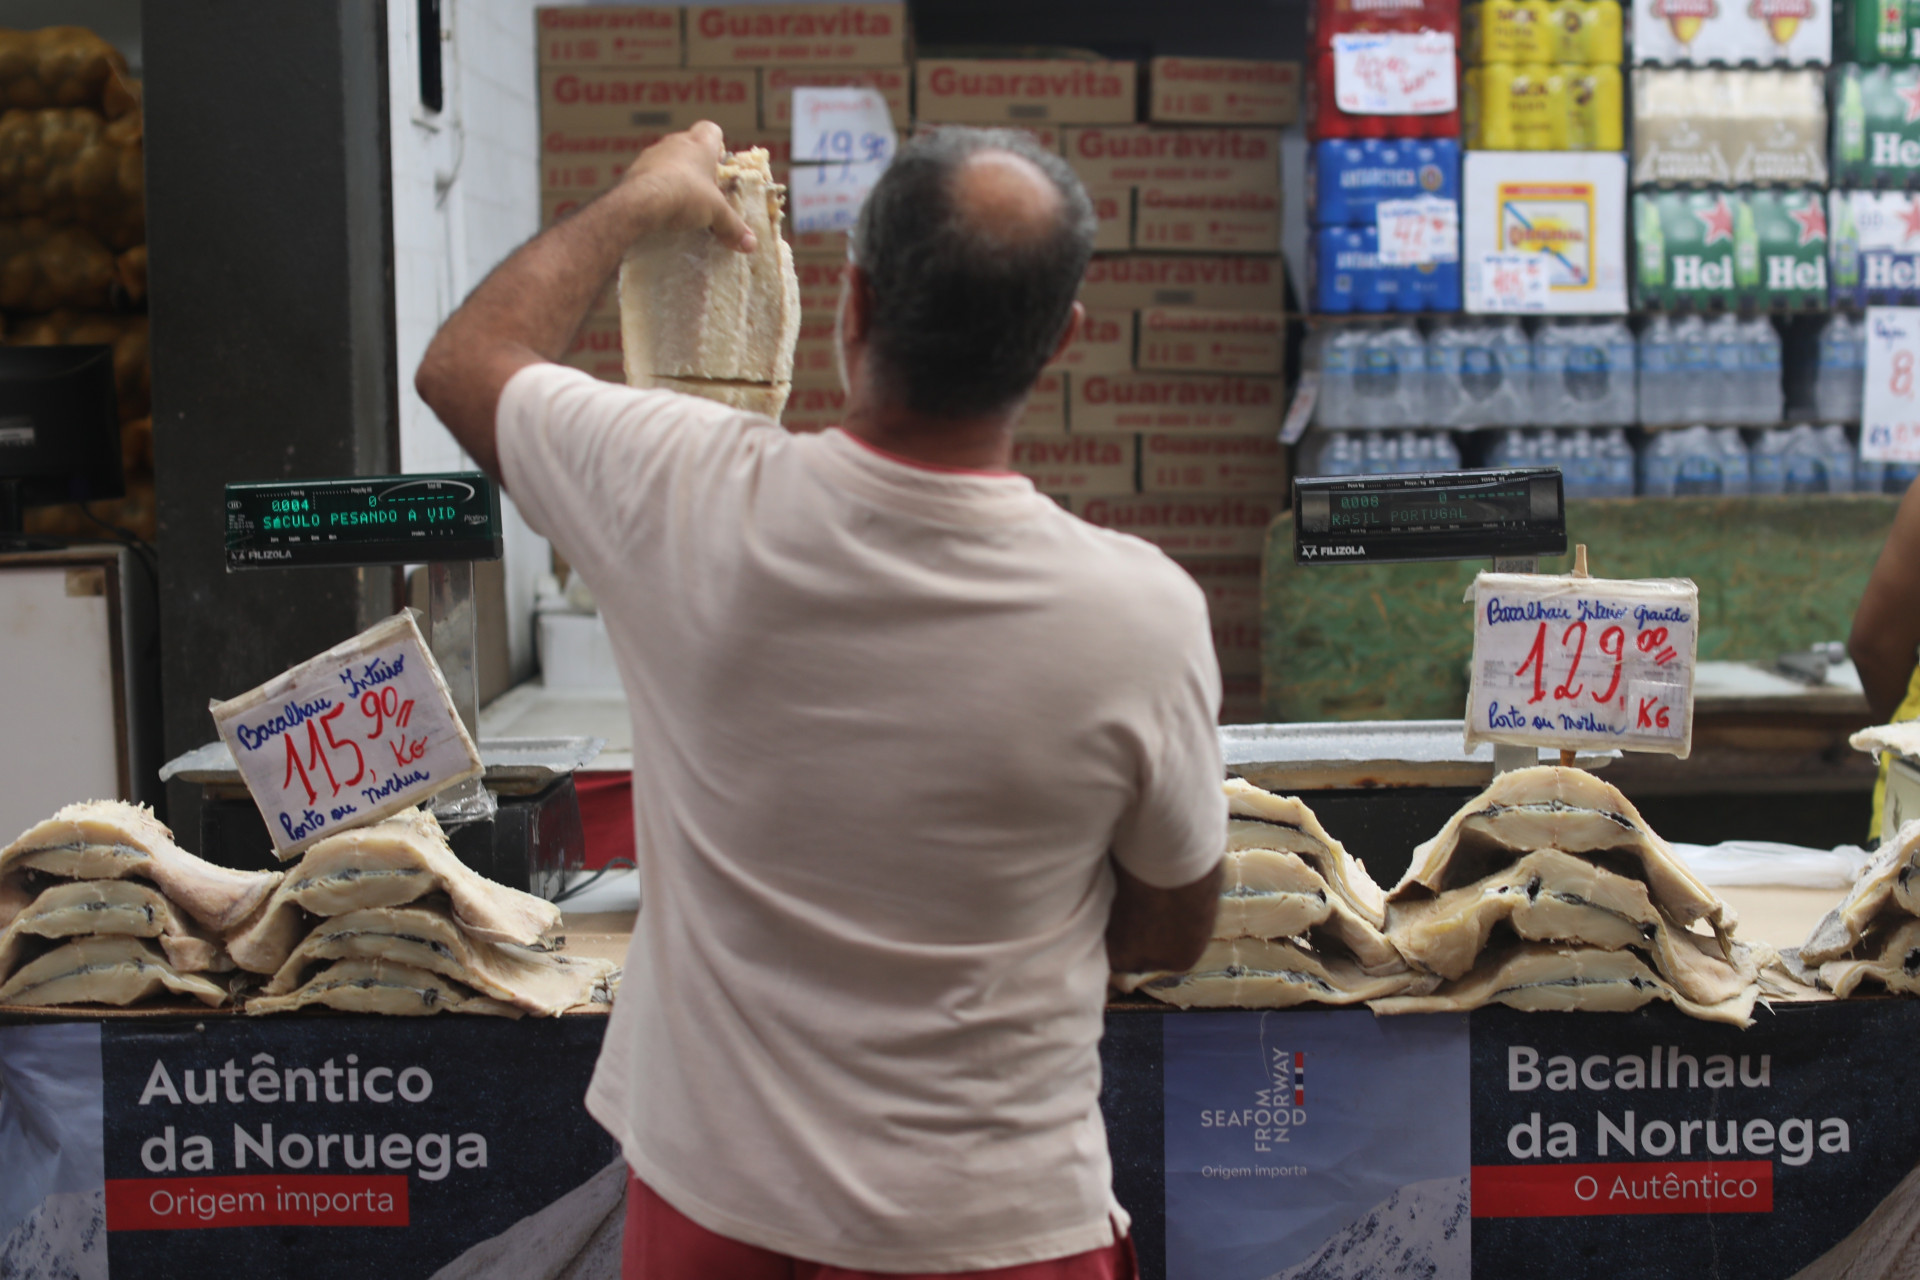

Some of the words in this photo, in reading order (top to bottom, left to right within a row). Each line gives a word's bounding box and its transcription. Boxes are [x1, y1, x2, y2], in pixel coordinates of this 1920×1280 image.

[541, 9, 673, 29] Guaravita
[700, 9, 891, 37] Guaravita
[929, 67, 1123, 97] Guaravita
[1161, 59, 1293, 83] Guaravita
[553, 75, 746, 105] Guaravita
[1078, 130, 1267, 159] Guaravita
[1083, 377, 1272, 405] Guaravita
[331, 509, 397, 526] PESANDO
[408, 508, 417, 522] A
[427, 506, 456, 523] VID
[1083, 500, 1271, 527] Guaravita
[1332, 512, 1380, 526] RASIL
[1391, 507, 1467, 521] PORTUGAL
[248, 549, 292, 560] FILIZOLA
[1320, 545, 1366, 556] FILIZOLA
[1487, 597, 1571, 626] Bacalhau
[237, 697, 331, 750] Bacalhau
[340, 654, 405, 699] Inteiro
[1488, 701, 1526, 730] Porto
[1532, 716, 1555, 730] ou
[279, 809, 325, 842] Porto
[331, 804, 357, 820] ou
[138, 1052, 433, 1105] Autêntico
[1508, 1045, 1771, 1092] Bacalhau
[1273, 1047, 1290, 1143] NORWAY
[1200, 1108, 1308, 1128] SEAFOOD
[1255, 1088, 1271, 1152] FROM
[141, 1126, 214, 1172] da
[234, 1122, 489, 1181] Noruega
[1507, 1112, 1578, 1160] da
[1597, 1110, 1850, 1166] Noruega
[1201, 1163, 1251, 1180] Origem
[1255, 1163, 1307, 1179] importa
[1574, 1174, 1599, 1201] O
[1608, 1171, 1759, 1201] Autêntico
[149, 1187, 266, 1221] Origem
[276, 1184, 394, 1217] importa
